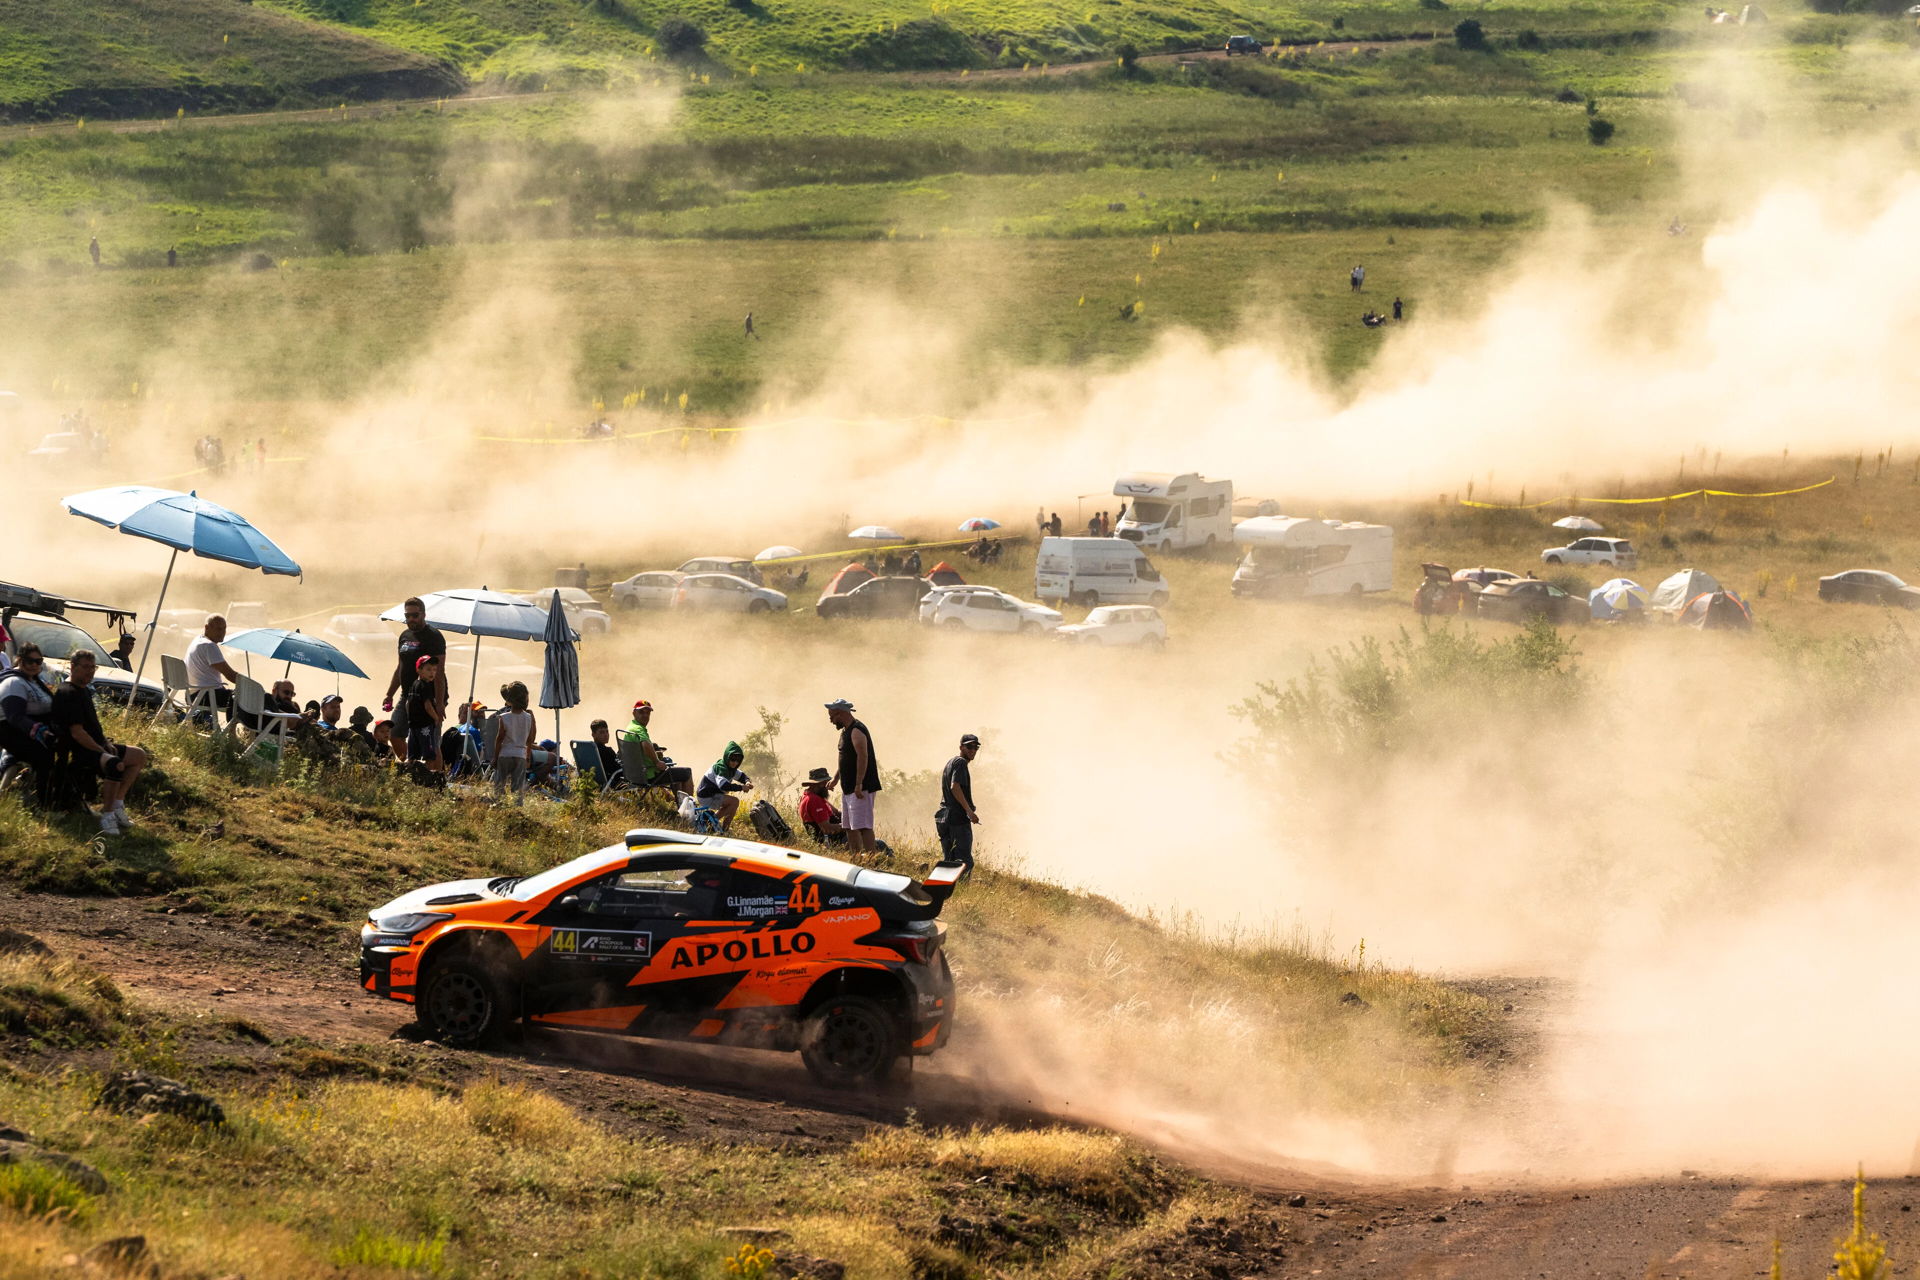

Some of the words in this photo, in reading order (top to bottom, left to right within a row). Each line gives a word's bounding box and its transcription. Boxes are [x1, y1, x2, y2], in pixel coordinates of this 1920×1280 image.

[727, 895, 774, 907] G.Linnamäe
[788, 883, 821, 913] 44
[737, 905, 774, 918] J.Morgan
[553, 931, 576, 952] 44
[671, 932, 816, 970] APOLLO
